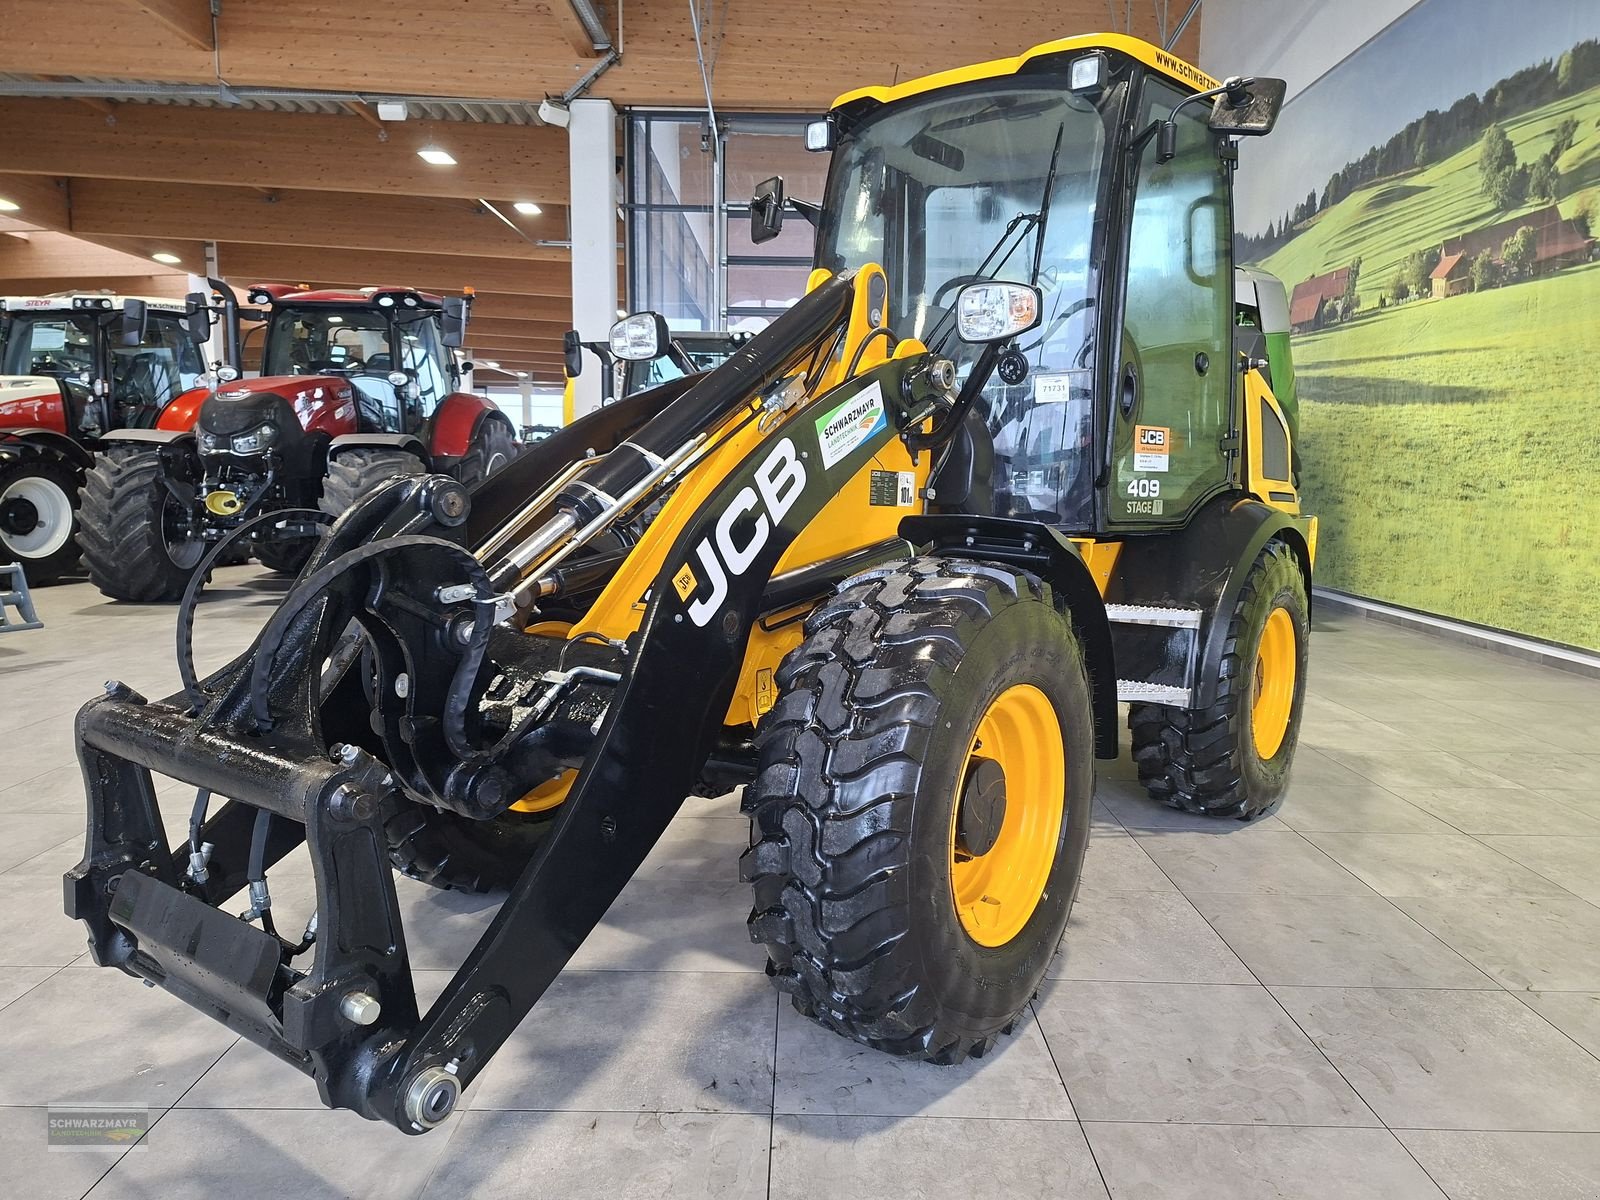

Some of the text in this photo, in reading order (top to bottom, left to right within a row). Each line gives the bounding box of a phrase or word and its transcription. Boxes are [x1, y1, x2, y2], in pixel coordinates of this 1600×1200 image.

[1042, 384, 1066, 393] 71731
[823, 398, 875, 440] SCHWARZMAYR
[1141, 430, 1165, 445] JCB
[1127, 479, 1160, 497] 409
[1126, 501, 1152, 513] STAGE
[687, 437, 807, 627] JCB
[679, 574, 691, 590] JCB
